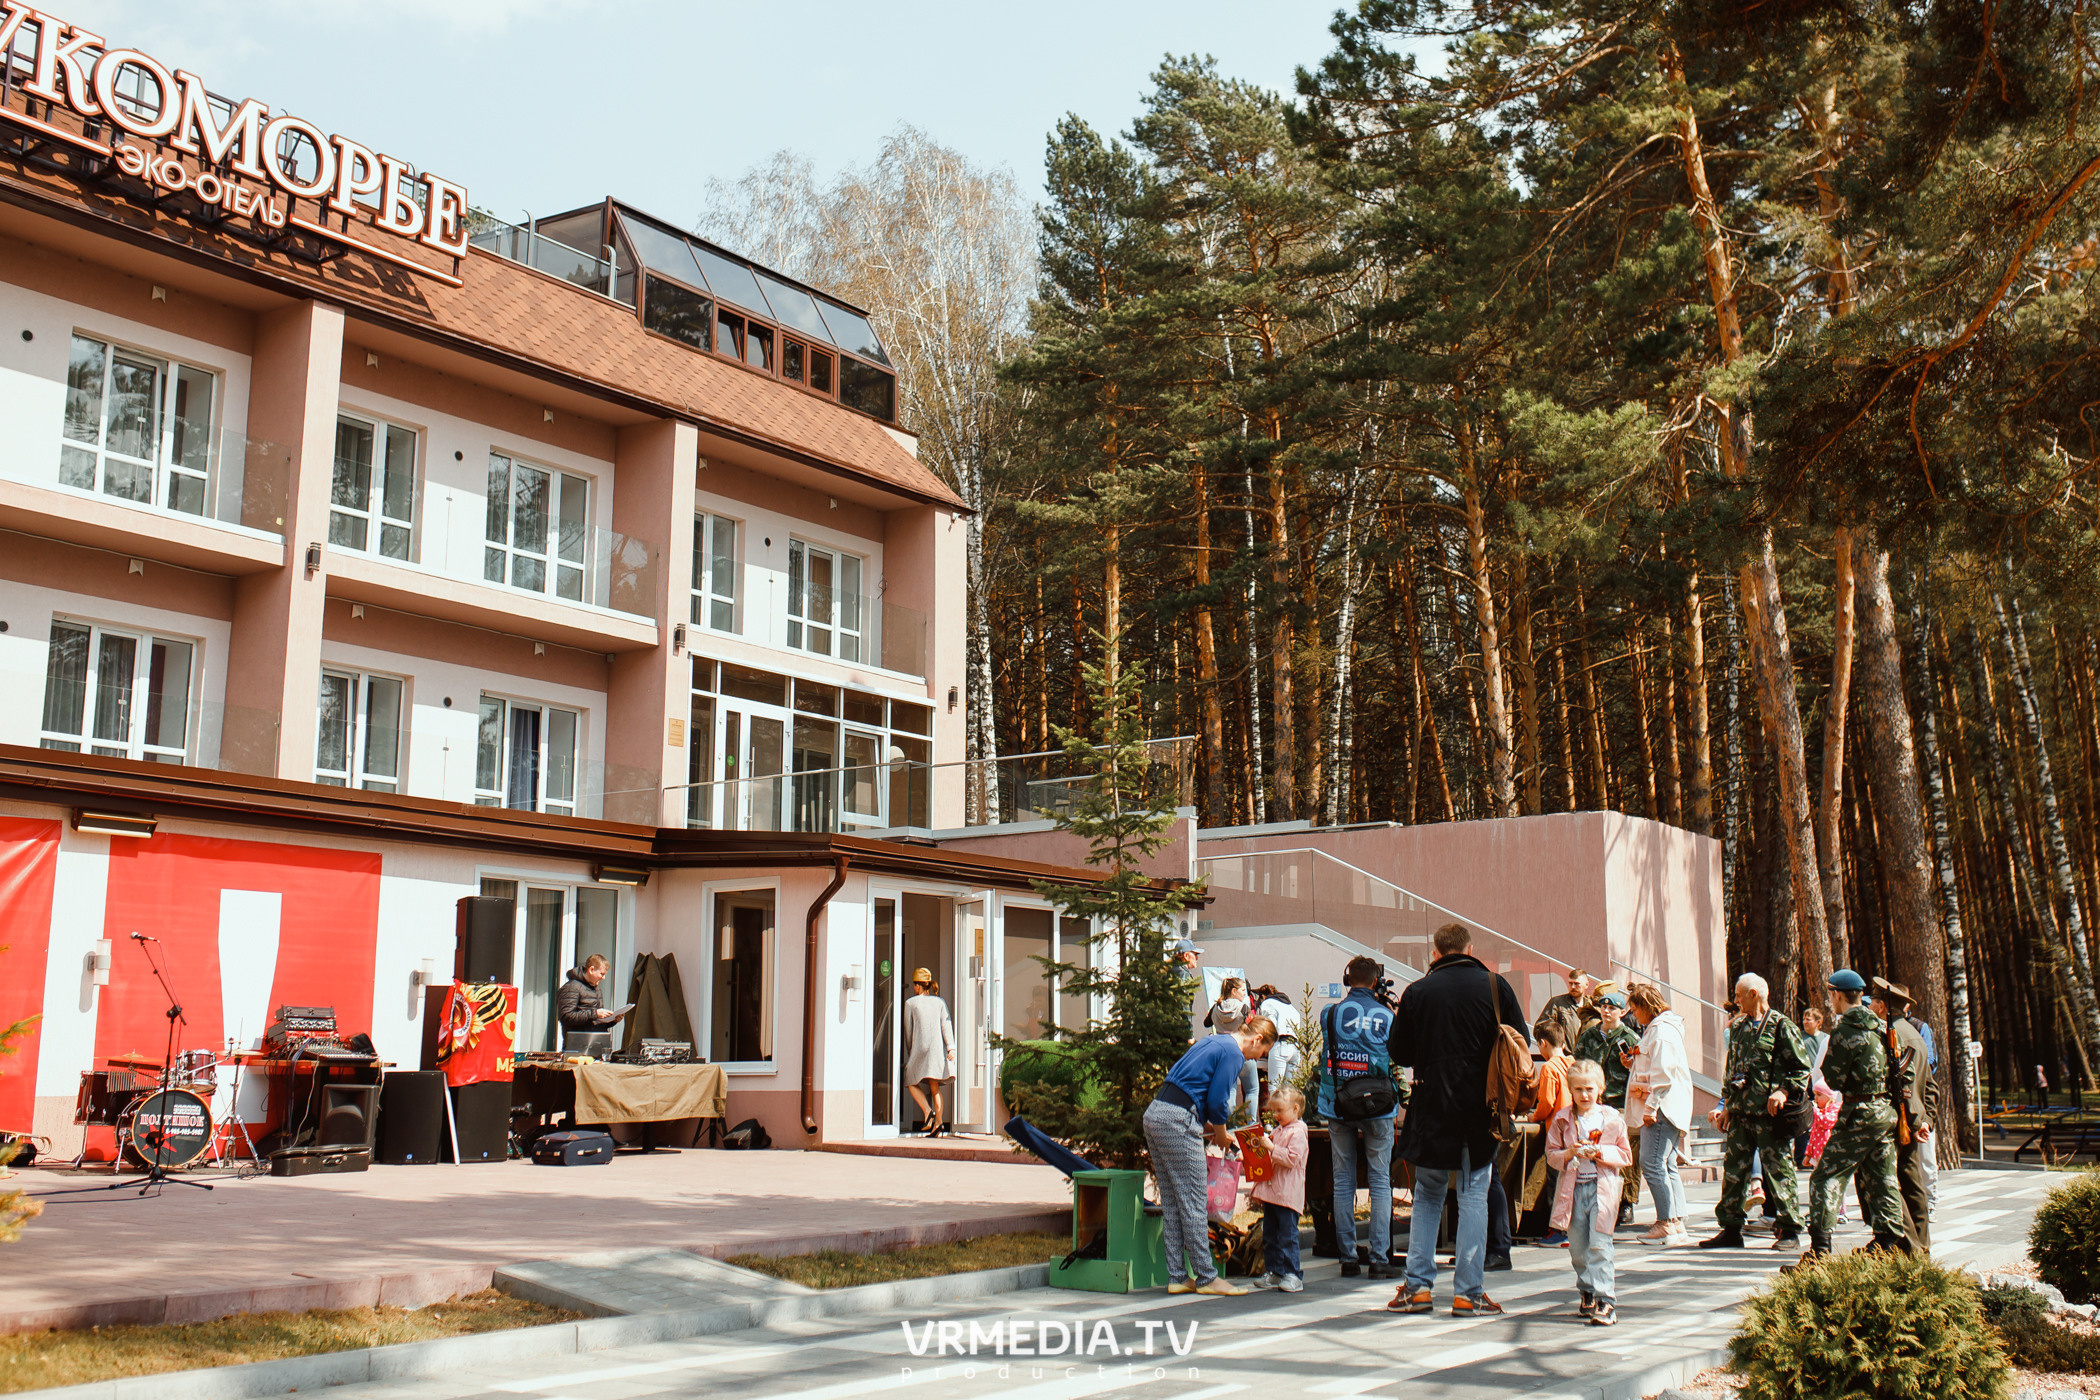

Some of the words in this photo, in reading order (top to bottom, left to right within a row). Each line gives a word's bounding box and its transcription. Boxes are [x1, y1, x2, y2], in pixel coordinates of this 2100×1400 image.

[116, 144, 286, 229] ЭКО-ОТЕЛЬ
[1344, 1016, 1383, 1031] ЛЕТ
[1327, 1049, 1369, 1062] ССИЯ
[1326, 1068, 1368, 1078] КЗБАС
